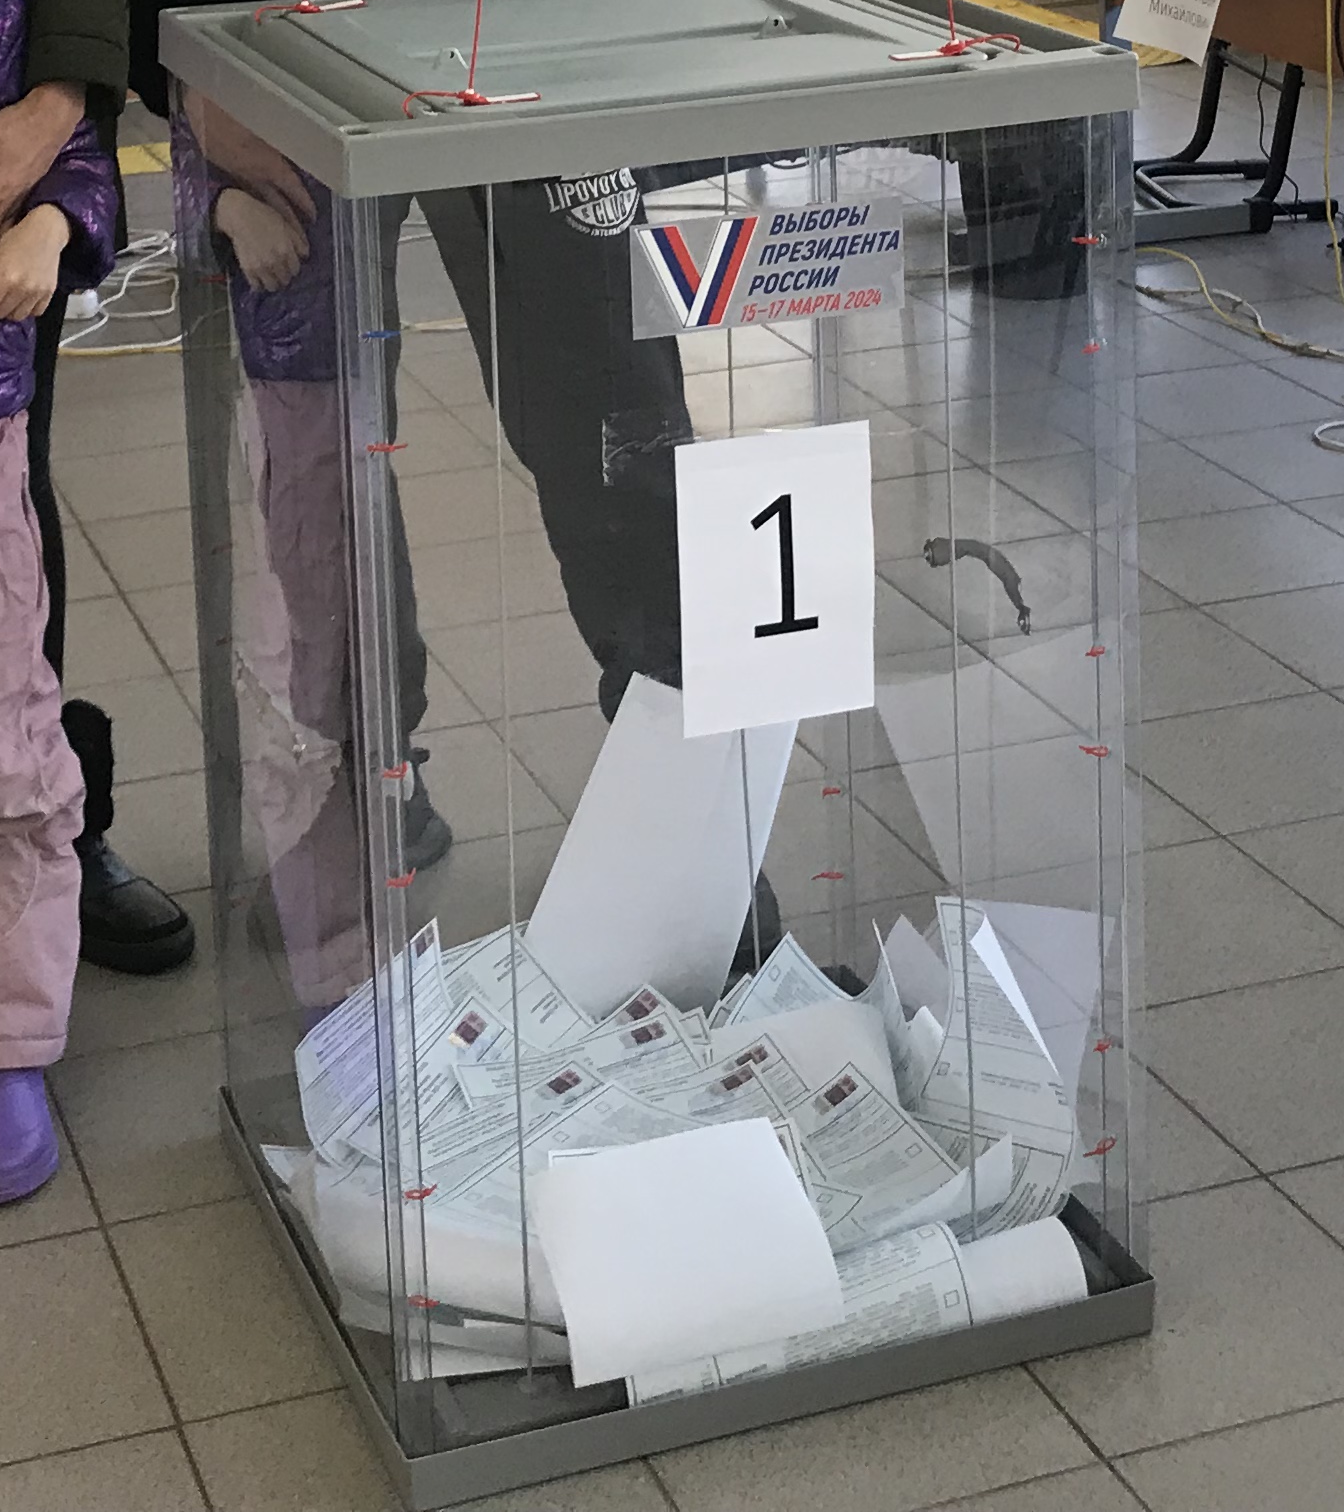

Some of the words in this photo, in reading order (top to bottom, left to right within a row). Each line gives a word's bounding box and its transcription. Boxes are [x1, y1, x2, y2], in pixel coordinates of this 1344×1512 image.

[768, 204, 871, 237] ВЫБОРЫ
[758, 229, 900, 267] ПРЕЗИДЕНТА
[747, 265, 841, 297] РОССИИ
[786, 293, 842, 317] МАРТА
[843, 288, 882, 310] 2024
[750, 494, 819, 639] 1
